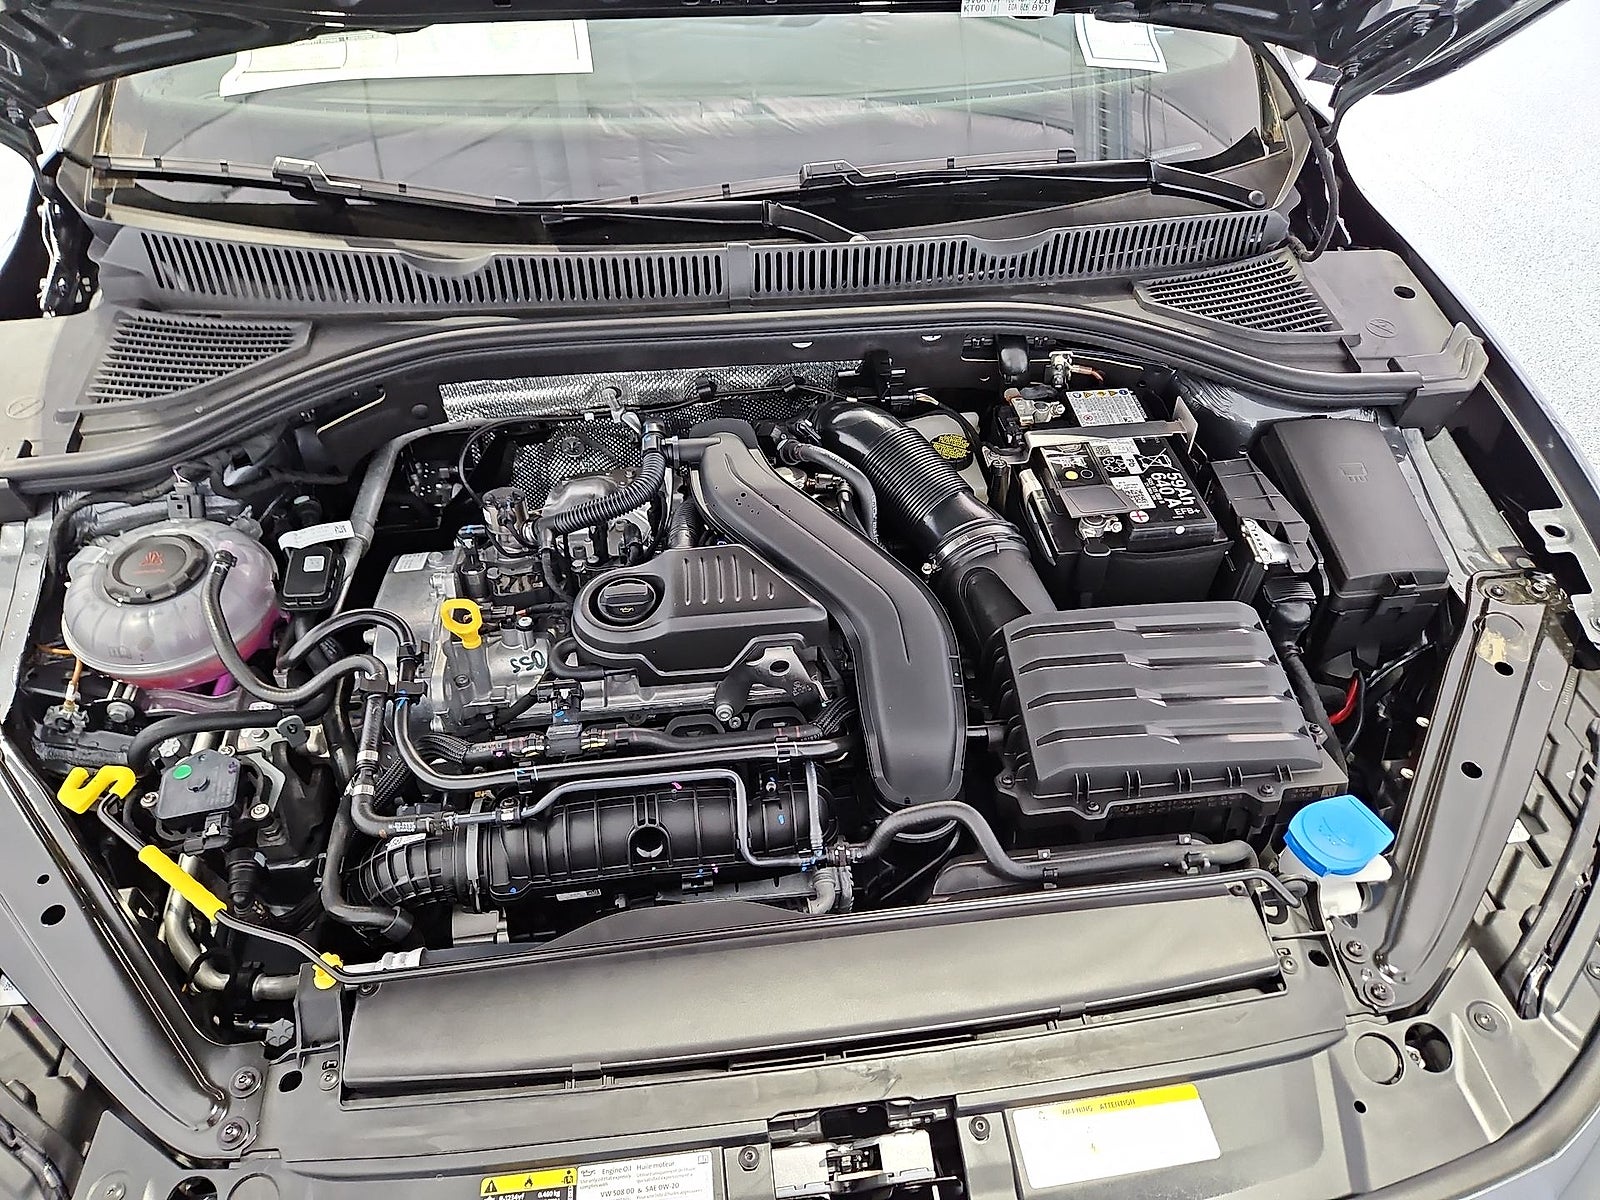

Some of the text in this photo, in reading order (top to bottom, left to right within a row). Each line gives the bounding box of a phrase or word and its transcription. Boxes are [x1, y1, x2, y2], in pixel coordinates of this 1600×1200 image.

[1150, 472, 1176, 495] 640
[1163, 498, 1183, 509] A
[1166, 472, 1197, 506] 59Ah
[1173, 507, 1201, 516] EFB+
[1099, 1098, 1137, 1111] ATTENTION
[601, 1167, 622, 1176] Engine
[600, 1190, 612, 1198] VW
[612, 1188, 625, 1197] 508
